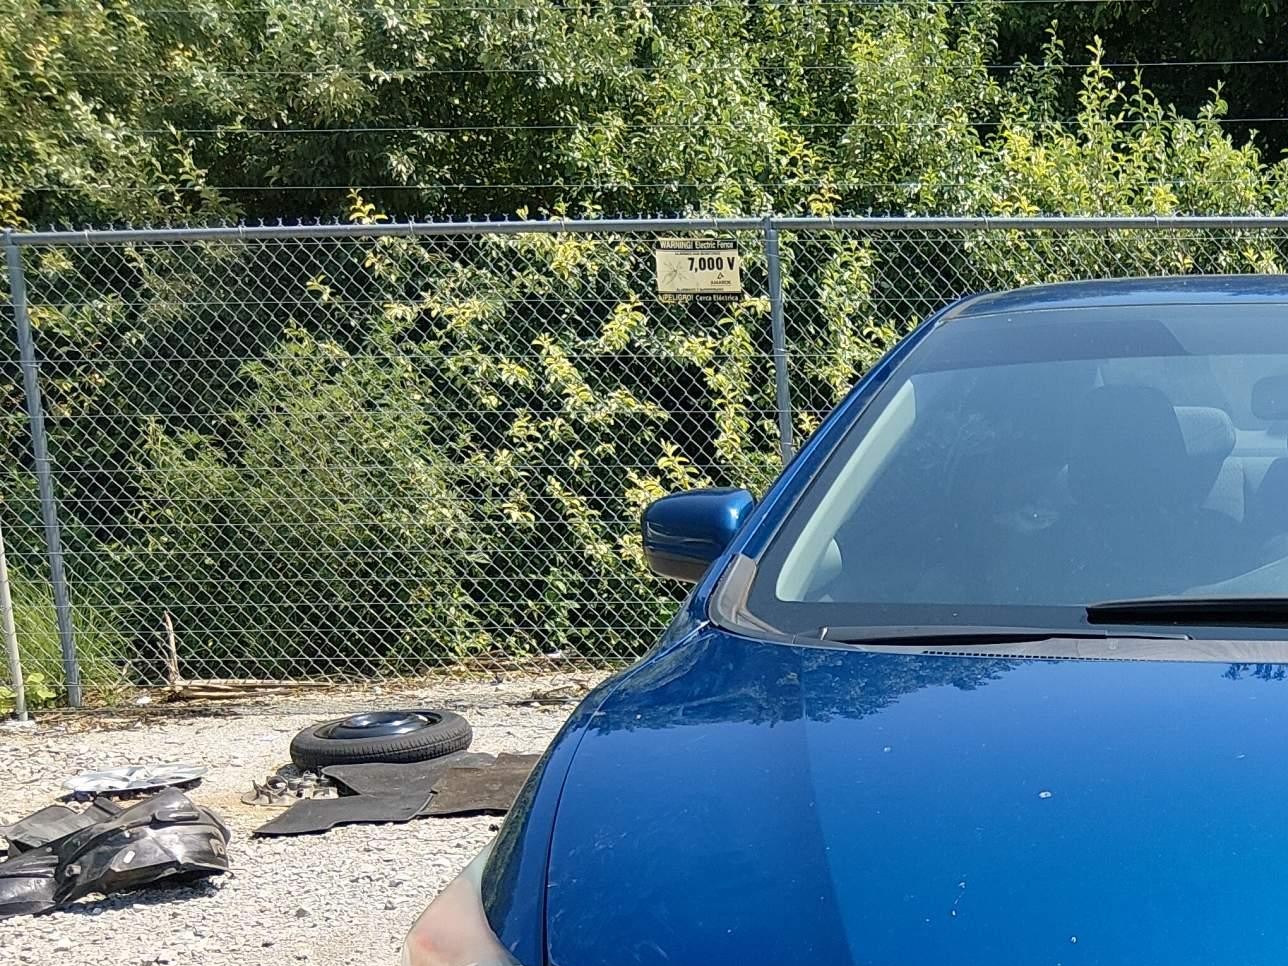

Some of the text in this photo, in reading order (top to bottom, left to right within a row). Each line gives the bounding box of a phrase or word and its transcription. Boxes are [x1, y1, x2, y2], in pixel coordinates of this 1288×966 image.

[695, 240, 716, 249] Electric
[688, 256, 735, 273] 7,000 V
[695, 294, 712, 302] Cerca
